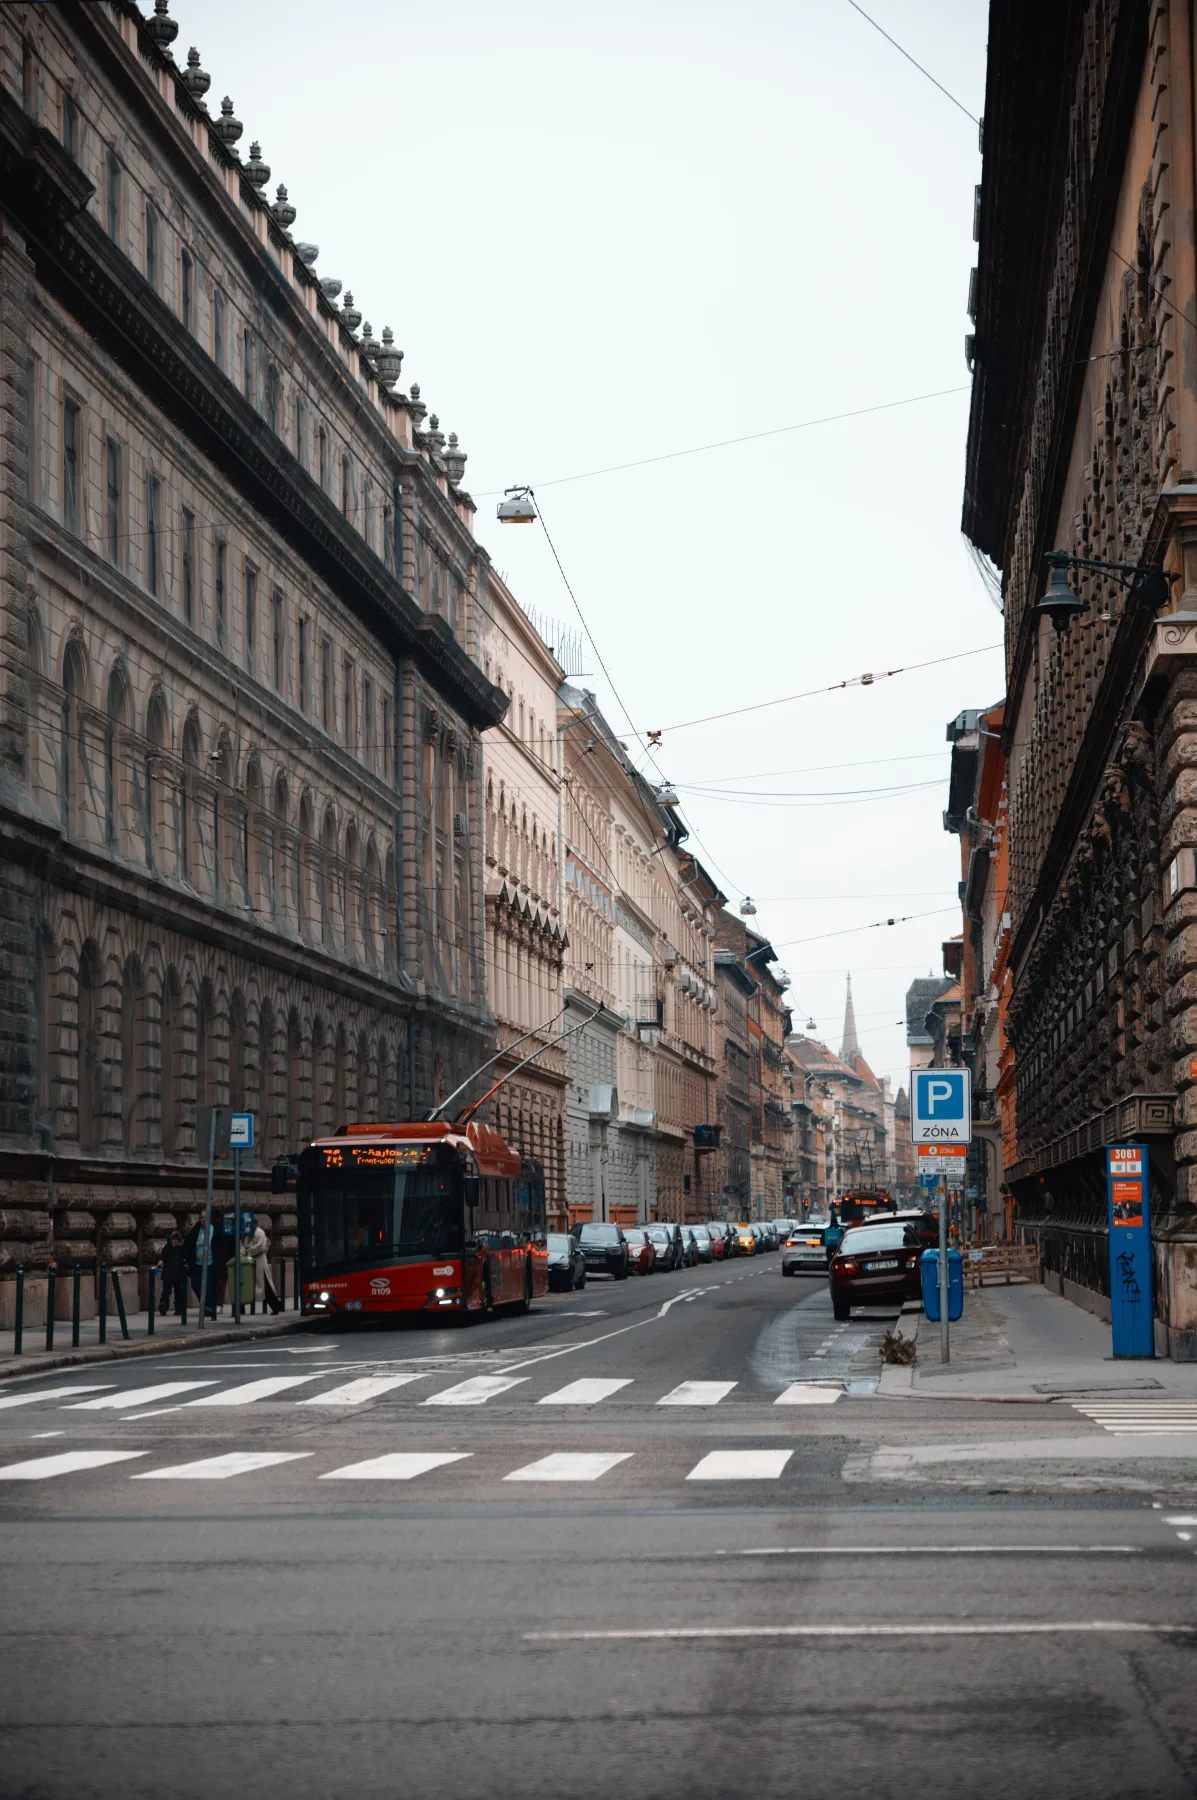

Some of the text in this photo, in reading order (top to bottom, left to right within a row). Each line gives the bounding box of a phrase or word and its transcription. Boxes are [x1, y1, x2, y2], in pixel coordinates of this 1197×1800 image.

[928, 1081, 953, 1115] P
[922, 1125, 959, 1137] ZÓNA
[1114, 1149, 1137, 1159] 3061
[371, 1287, 391, 1296] 8109
